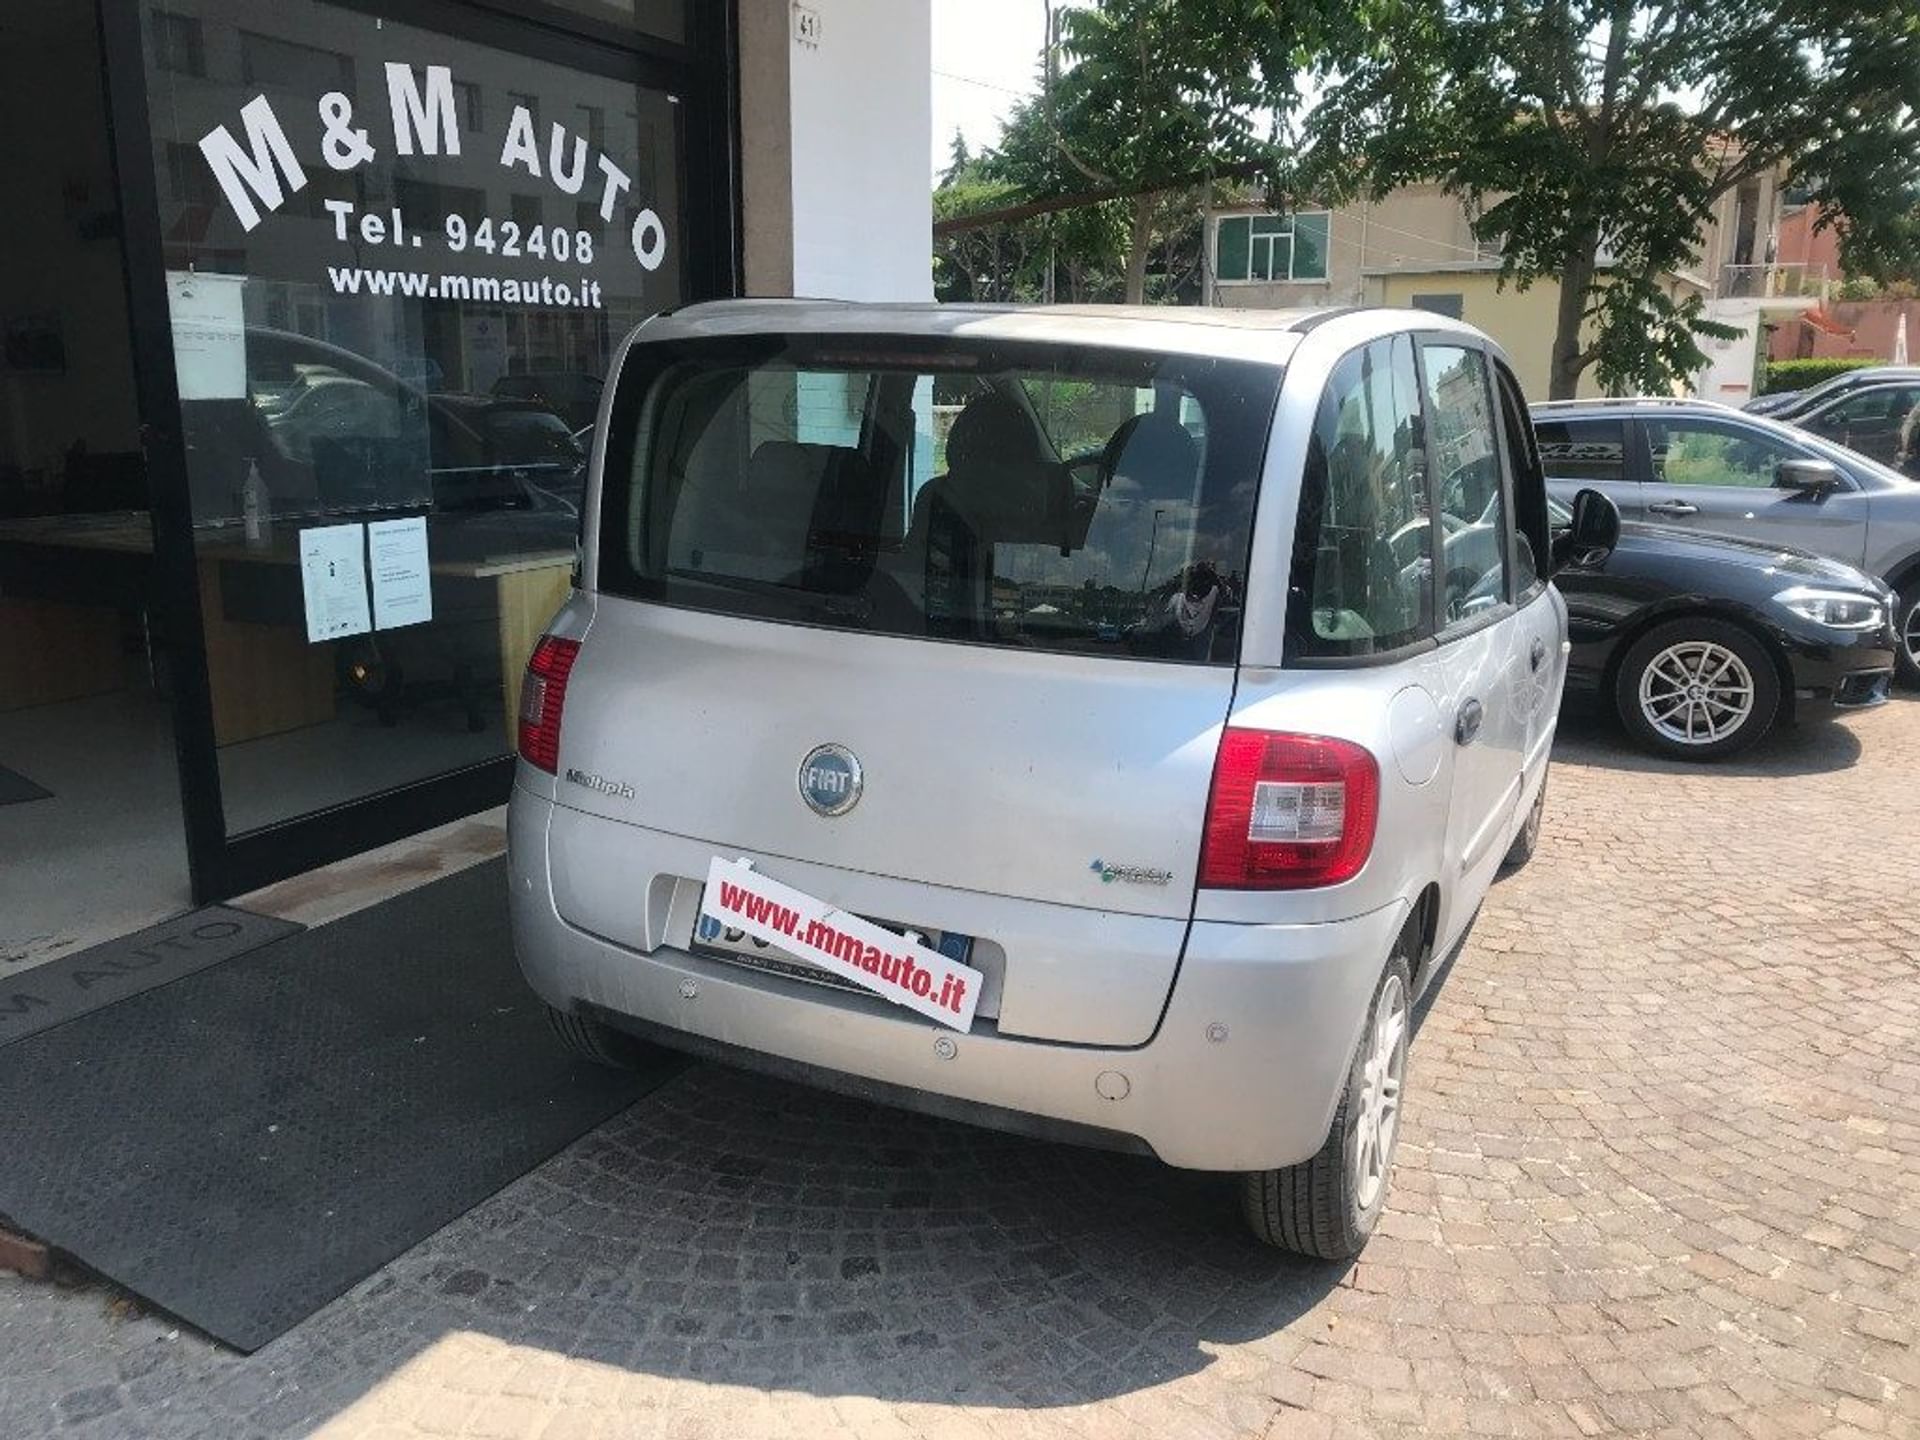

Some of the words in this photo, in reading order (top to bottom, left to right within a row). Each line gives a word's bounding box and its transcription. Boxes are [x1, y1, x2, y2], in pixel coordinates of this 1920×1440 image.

[318, 91, 376, 171] &
[500, 105, 666, 271] AUTO
[324, 199, 422, 248] Tel.
[445, 214, 594, 264] 942408
[327, 266, 602, 308] www.mmauto.it
[807, 766, 850, 793] FIAT
[71, 921, 243, 991] AUTO
[719, 880, 967, 1014] www.mmauto.it
